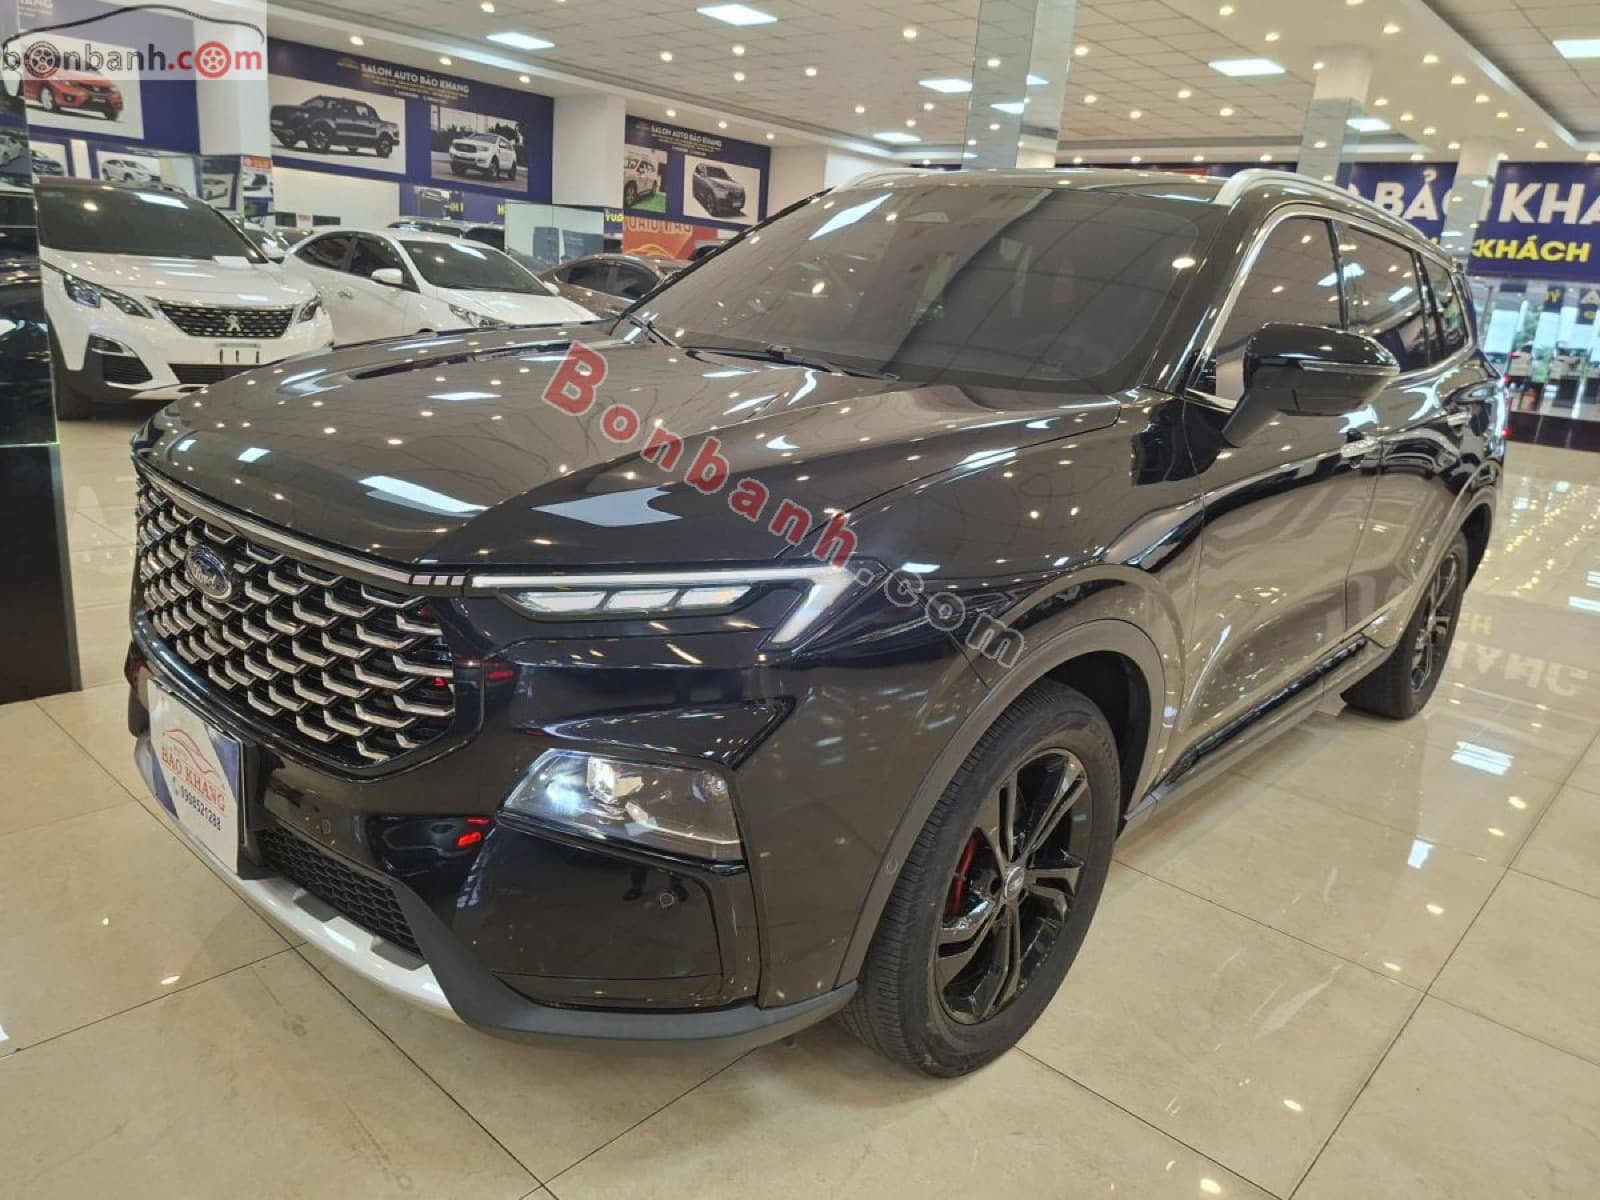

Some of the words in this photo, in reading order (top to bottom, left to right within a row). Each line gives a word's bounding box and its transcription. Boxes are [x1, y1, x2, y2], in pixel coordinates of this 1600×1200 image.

[360, 63, 392, 77] SALON
[393, 70, 418, 82] AUTO
[439, 79, 470, 93] KHANG
[1474, 235, 1591, 262] KHÁCH
[185, 767, 225, 812] KHANG
